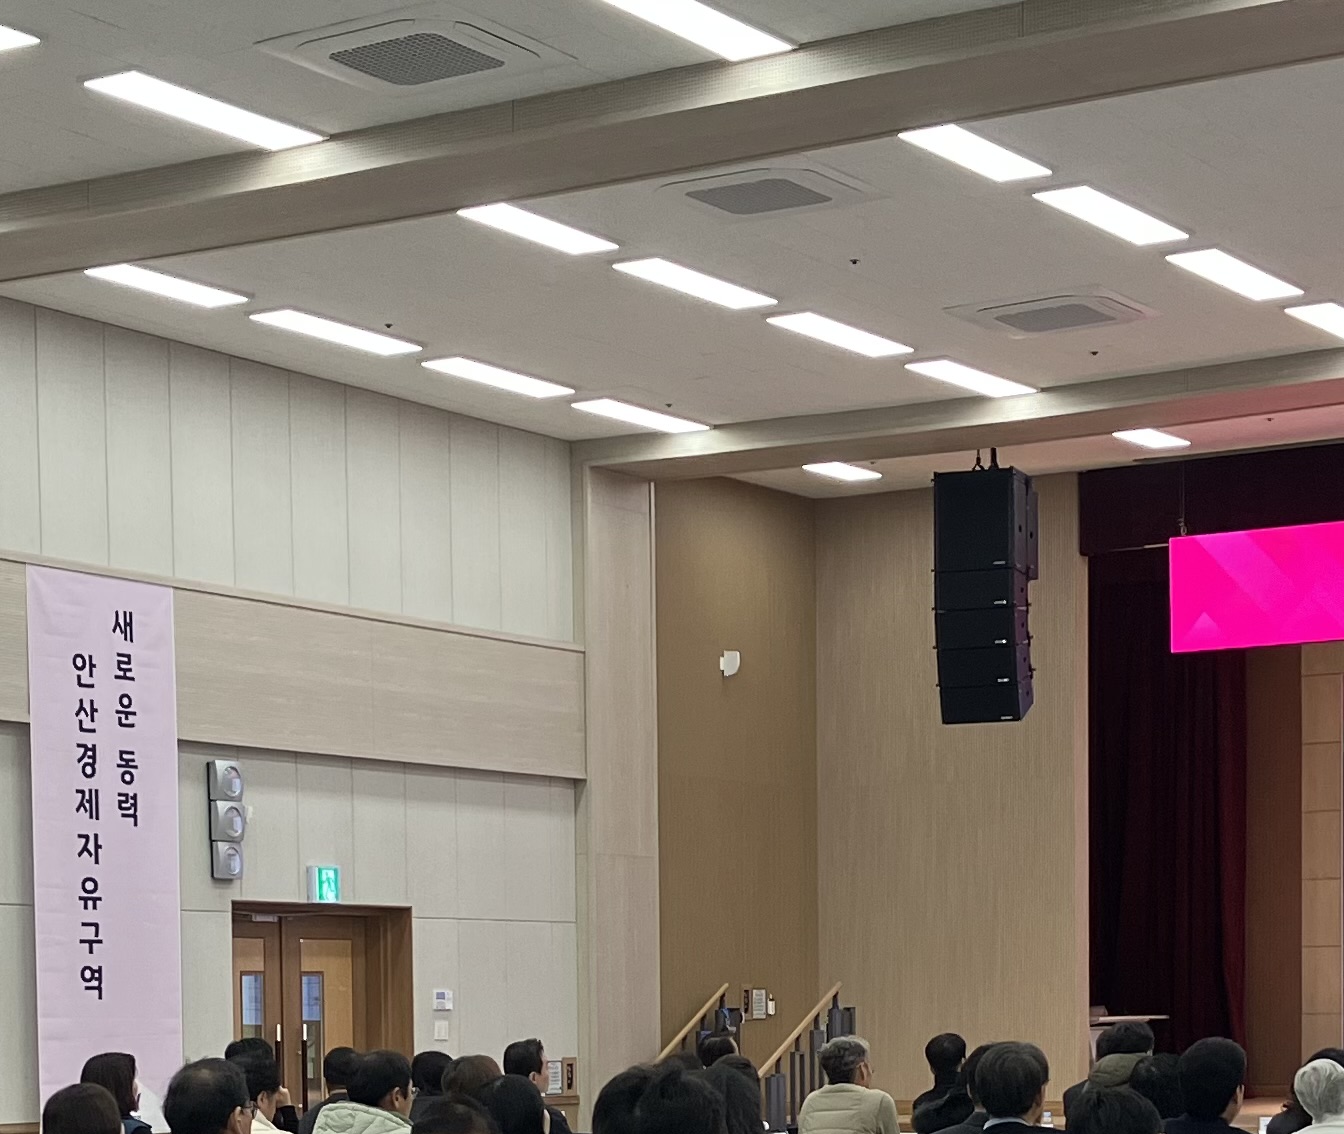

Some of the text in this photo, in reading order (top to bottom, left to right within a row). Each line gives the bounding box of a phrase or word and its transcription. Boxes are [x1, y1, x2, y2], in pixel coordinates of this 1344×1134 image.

[73, 653, 103, 1001] 안산경제자유구역
[112, 610, 139, 828] 새로운 동력
